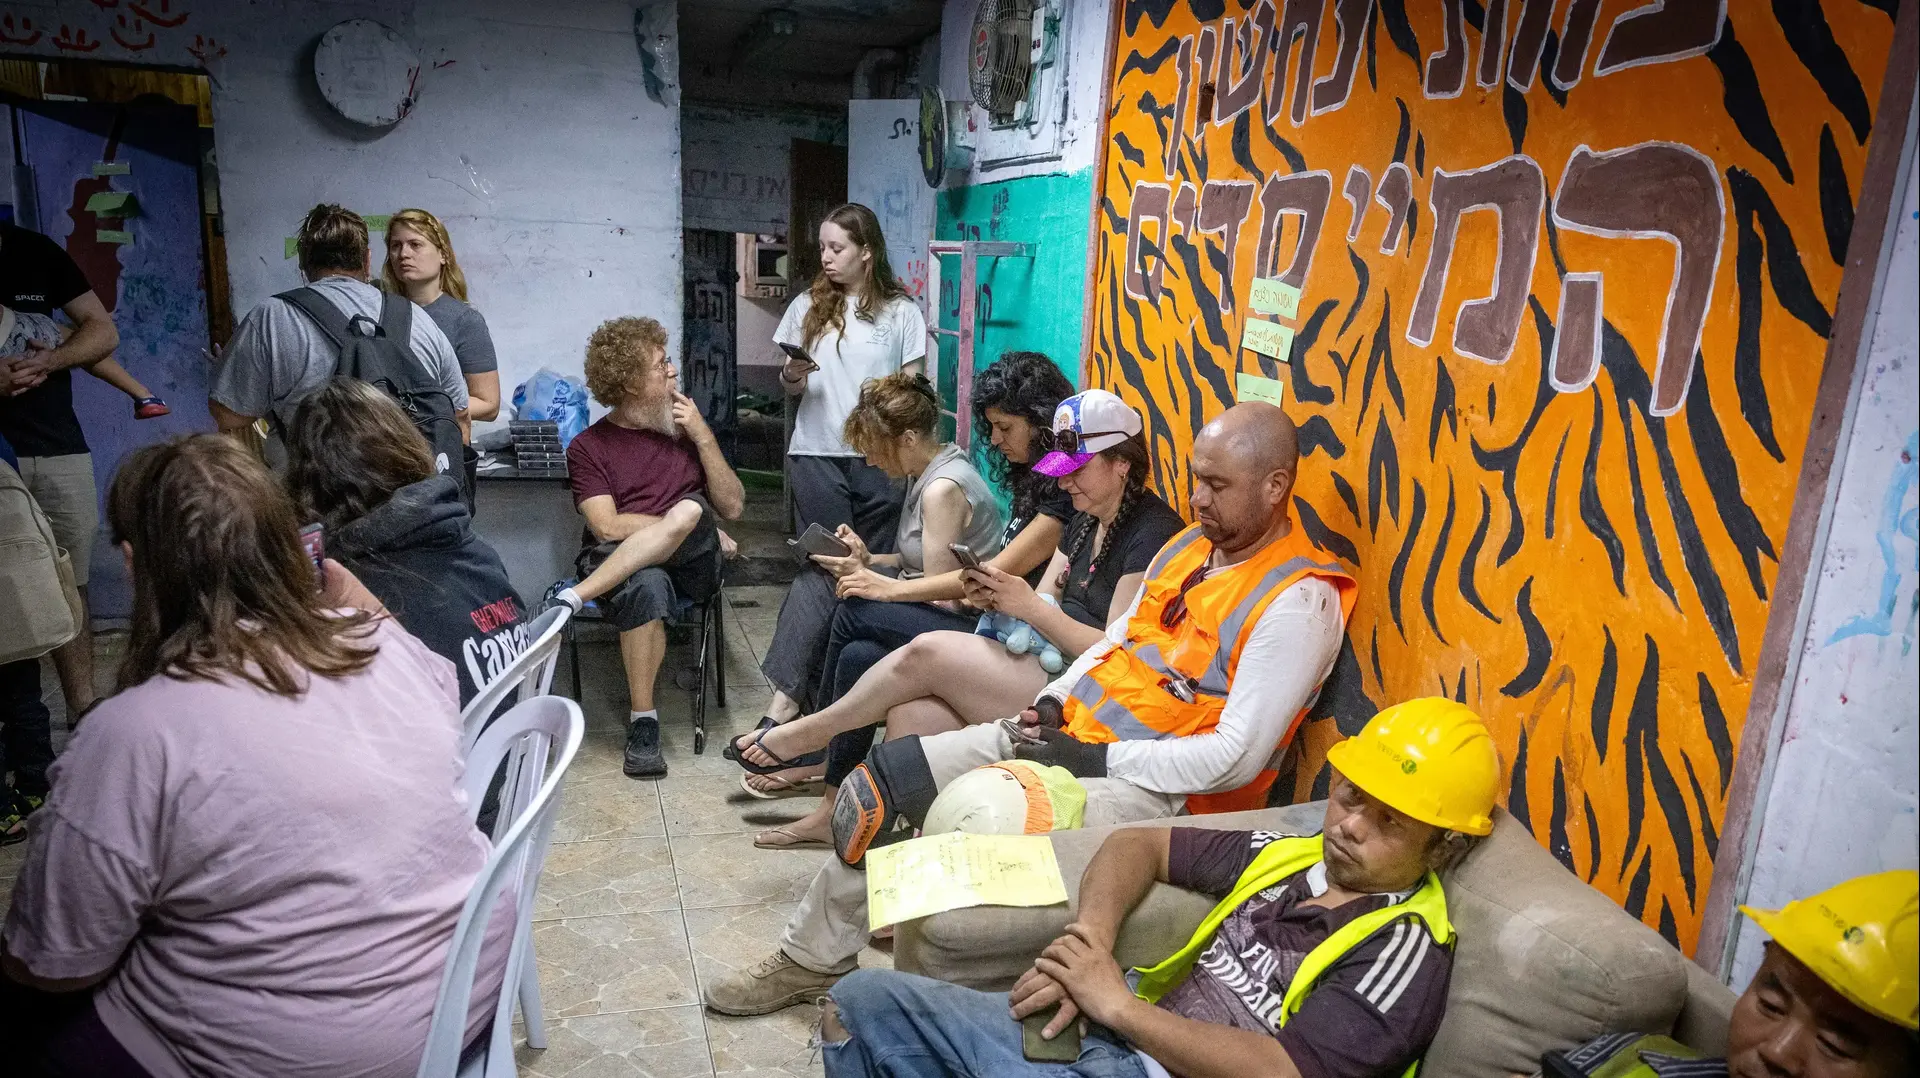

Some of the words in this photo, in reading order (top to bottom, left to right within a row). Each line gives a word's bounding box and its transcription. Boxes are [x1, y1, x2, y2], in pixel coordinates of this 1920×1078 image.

[14, 294, 46, 302] SPACEX
[1124, 140, 1727, 417] המייסדים
[1198, 935, 1283, 1031] Emirate
